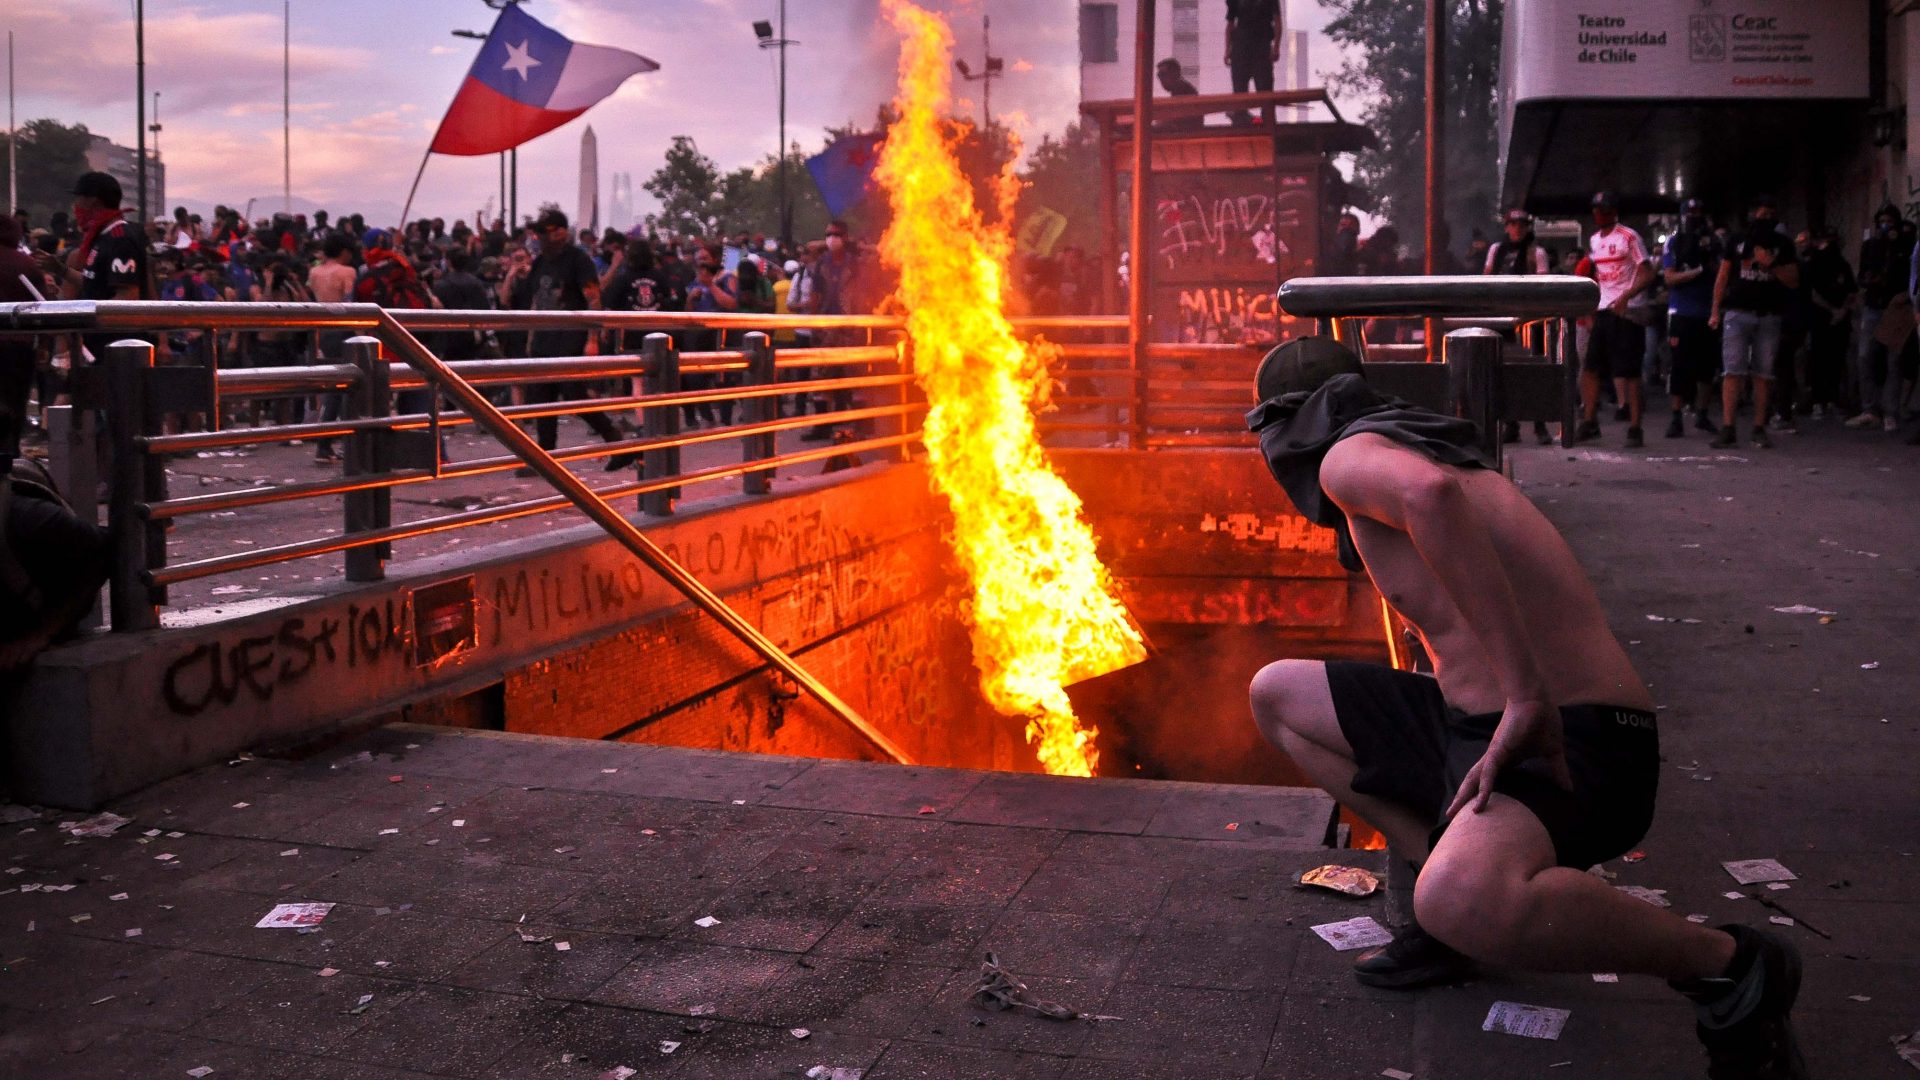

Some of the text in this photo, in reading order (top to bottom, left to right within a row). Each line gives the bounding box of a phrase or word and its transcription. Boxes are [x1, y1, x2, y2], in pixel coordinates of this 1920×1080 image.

[1577, 14, 1626, 28] Teatro
[1731, 13, 1778, 31] Ceac
[1577, 31, 1667, 46] Universidad
[1578, 48, 1637, 63] de Chile
